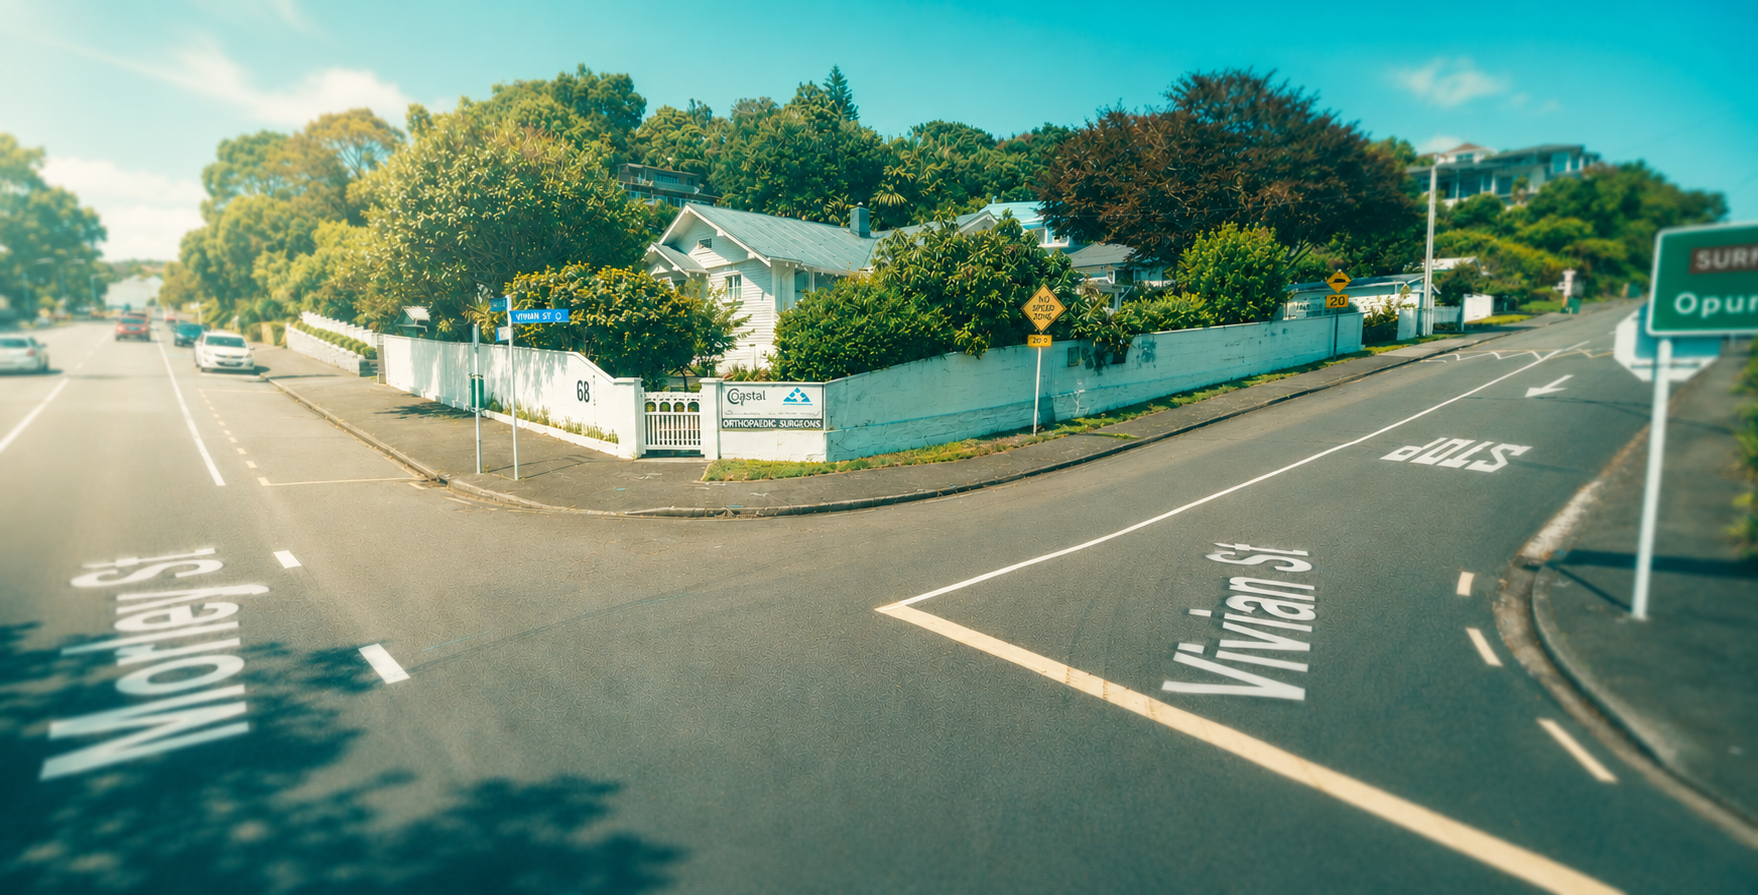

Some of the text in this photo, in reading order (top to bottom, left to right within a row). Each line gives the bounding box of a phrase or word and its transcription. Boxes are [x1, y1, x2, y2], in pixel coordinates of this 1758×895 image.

[1038, 296, 1050, 304] NO
[1330, 296, 1346, 307] 20
[516, 312, 552, 320] VIVIAN ST
[576, 379, 590, 403] 68
[727, 388, 766, 406] Coastal
[722, 419, 821, 429] ORTHOPAEDIC SURGEONS
[1379, 437, 1533, 473] STOP
[1161, 542, 1316, 700] Vivian St
[39, 547, 270, 781] Morley St
